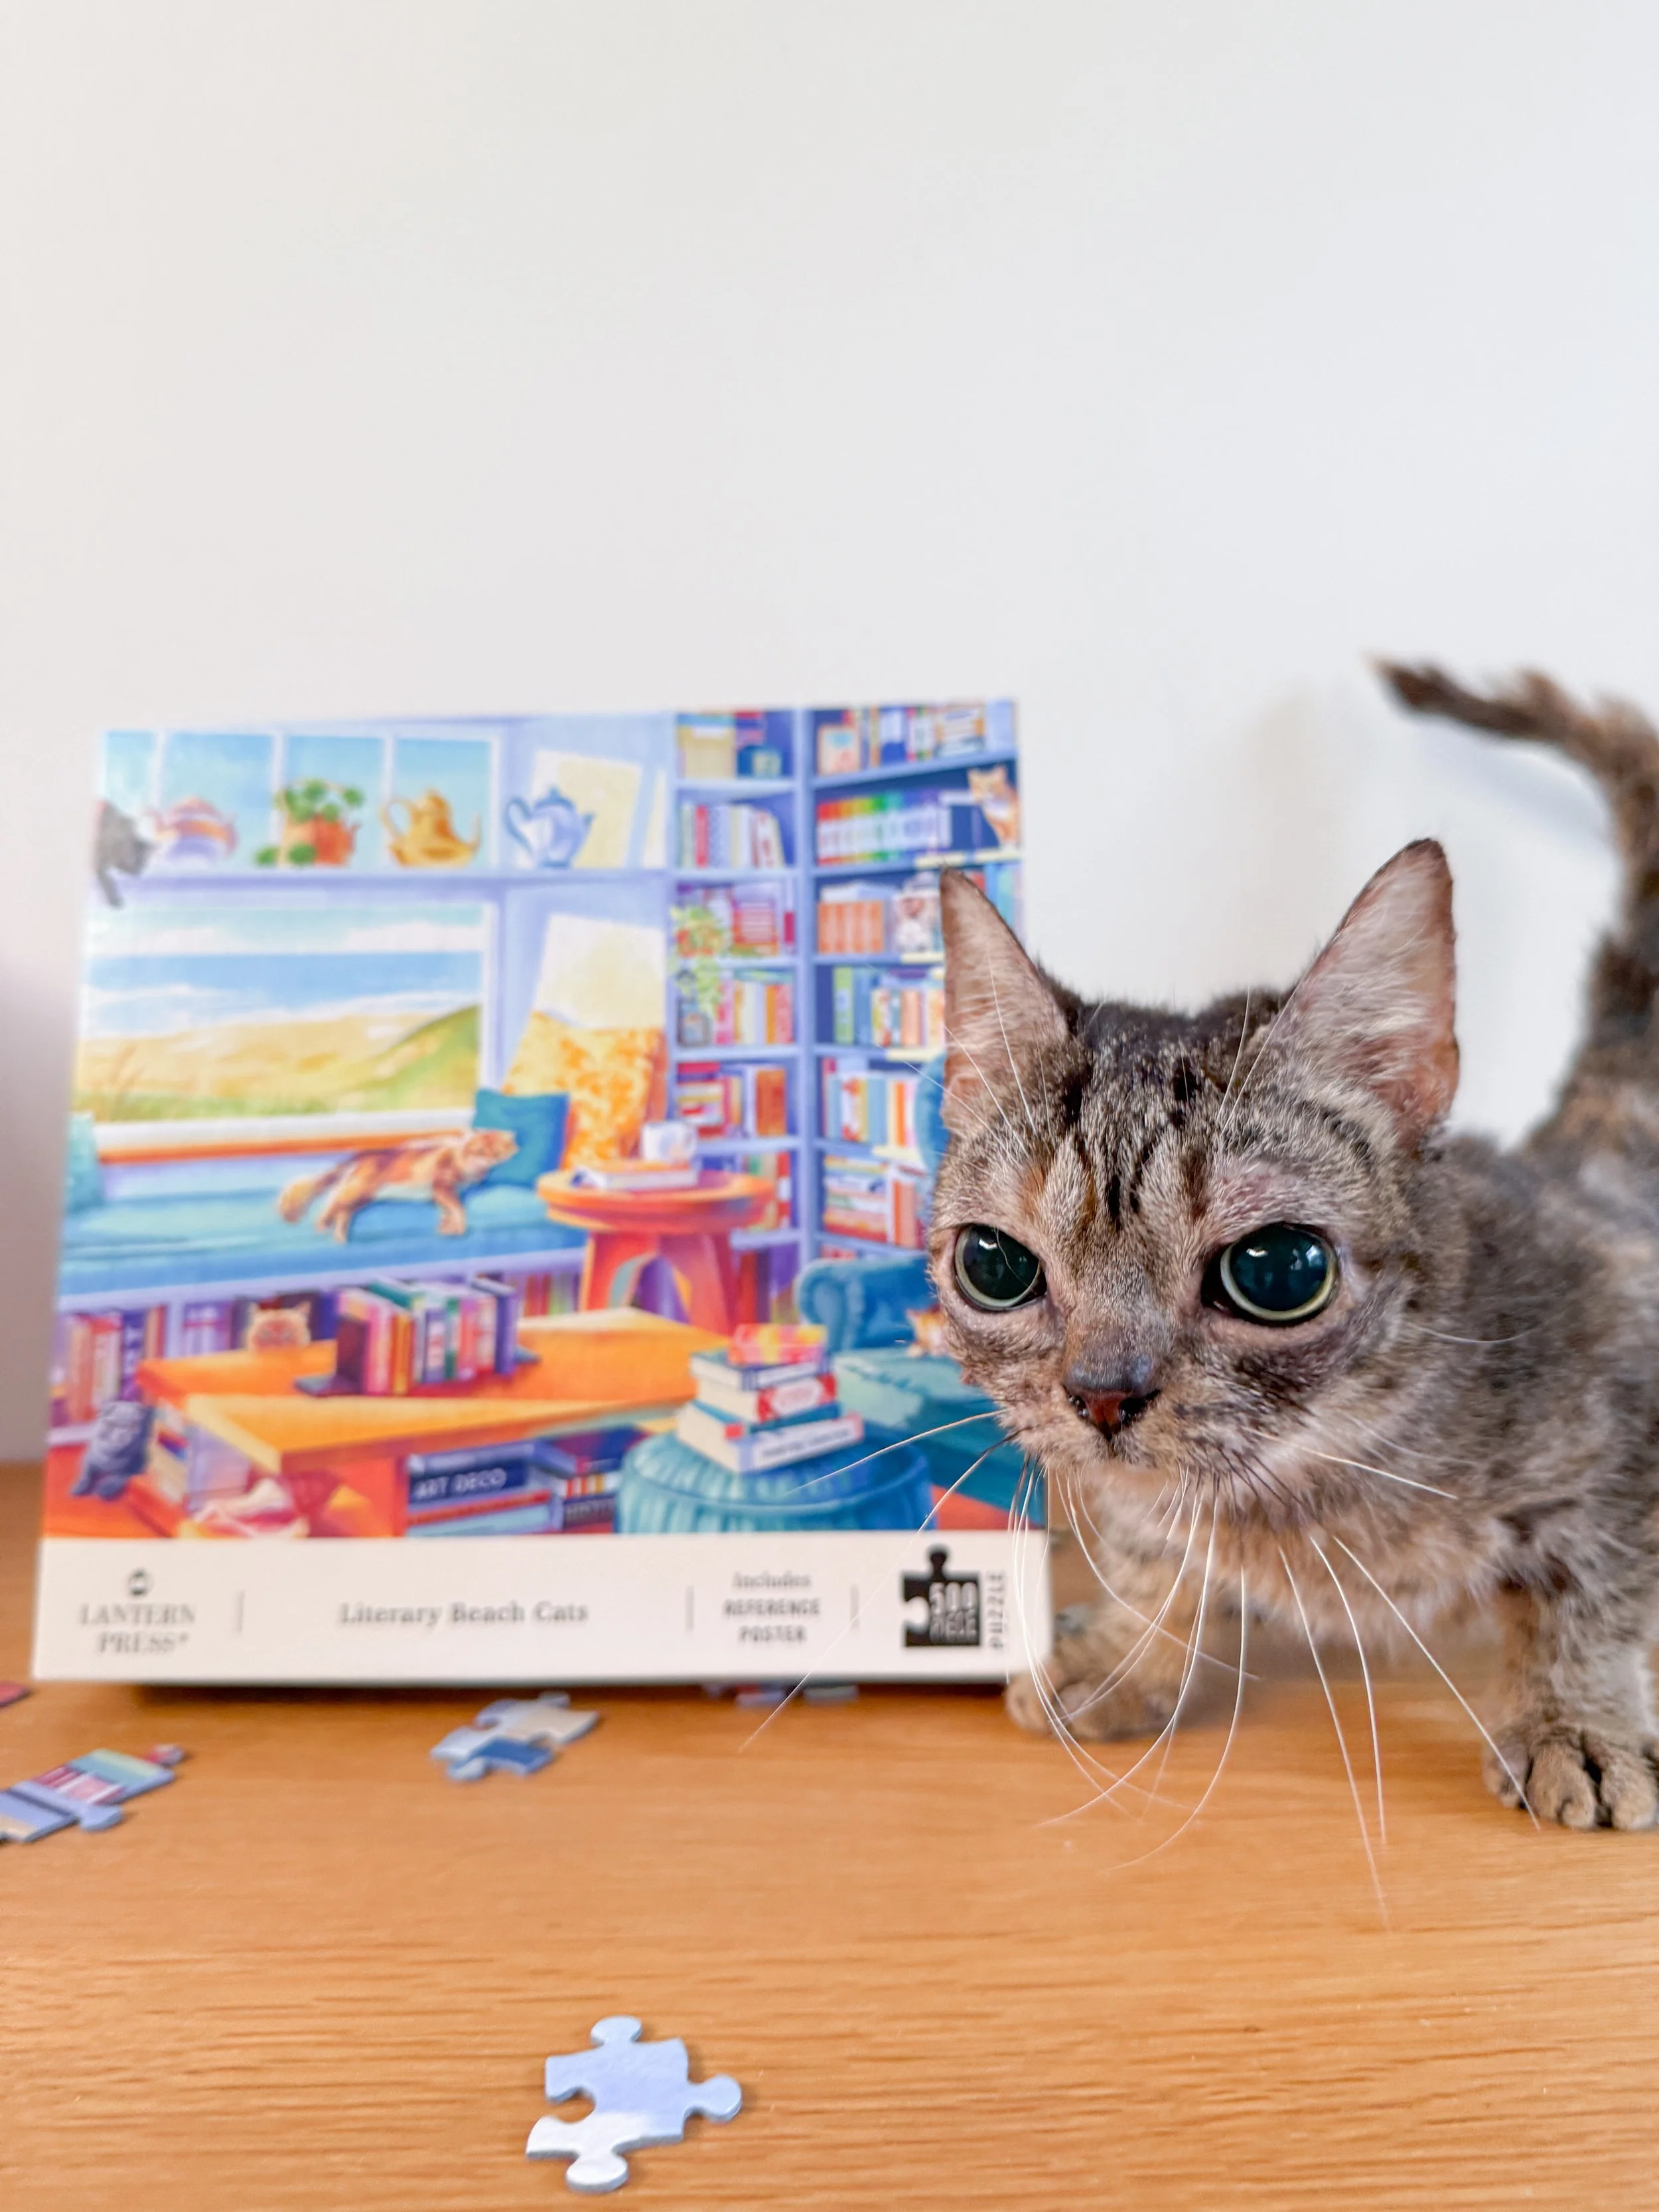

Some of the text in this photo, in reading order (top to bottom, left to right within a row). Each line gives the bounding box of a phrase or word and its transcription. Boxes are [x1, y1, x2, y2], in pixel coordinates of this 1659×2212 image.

[414, 1468, 507, 1498] ART DECO
[733, 1570, 811, 1589] Includes
[723, 1597, 821, 1617] REFERENCE
[929, 1582, 977, 1612] 500
[80, 1603, 196, 1626] LANTERN
[339, 1599, 589, 1629] Literary Beach Cats
[988, 1572, 1006, 1649] PUZZLE
[739, 1625, 806, 1644] POSTER
